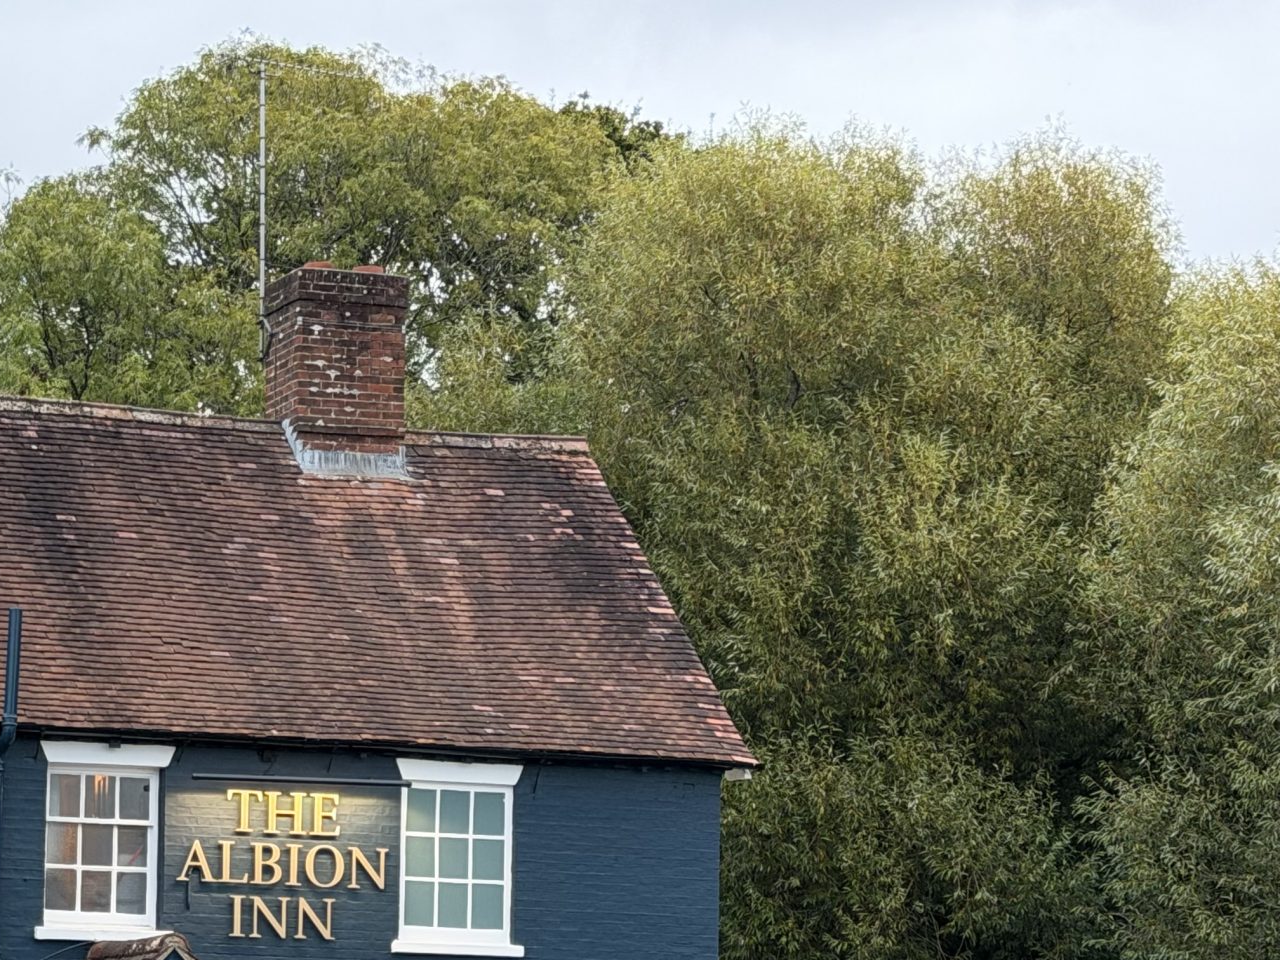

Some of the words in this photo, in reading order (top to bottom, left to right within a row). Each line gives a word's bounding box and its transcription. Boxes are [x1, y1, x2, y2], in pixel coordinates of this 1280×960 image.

[226, 788, 341, 837] THE
[175, 839, 390, 890] ALBION
[228, 894, 337, 941] INN
